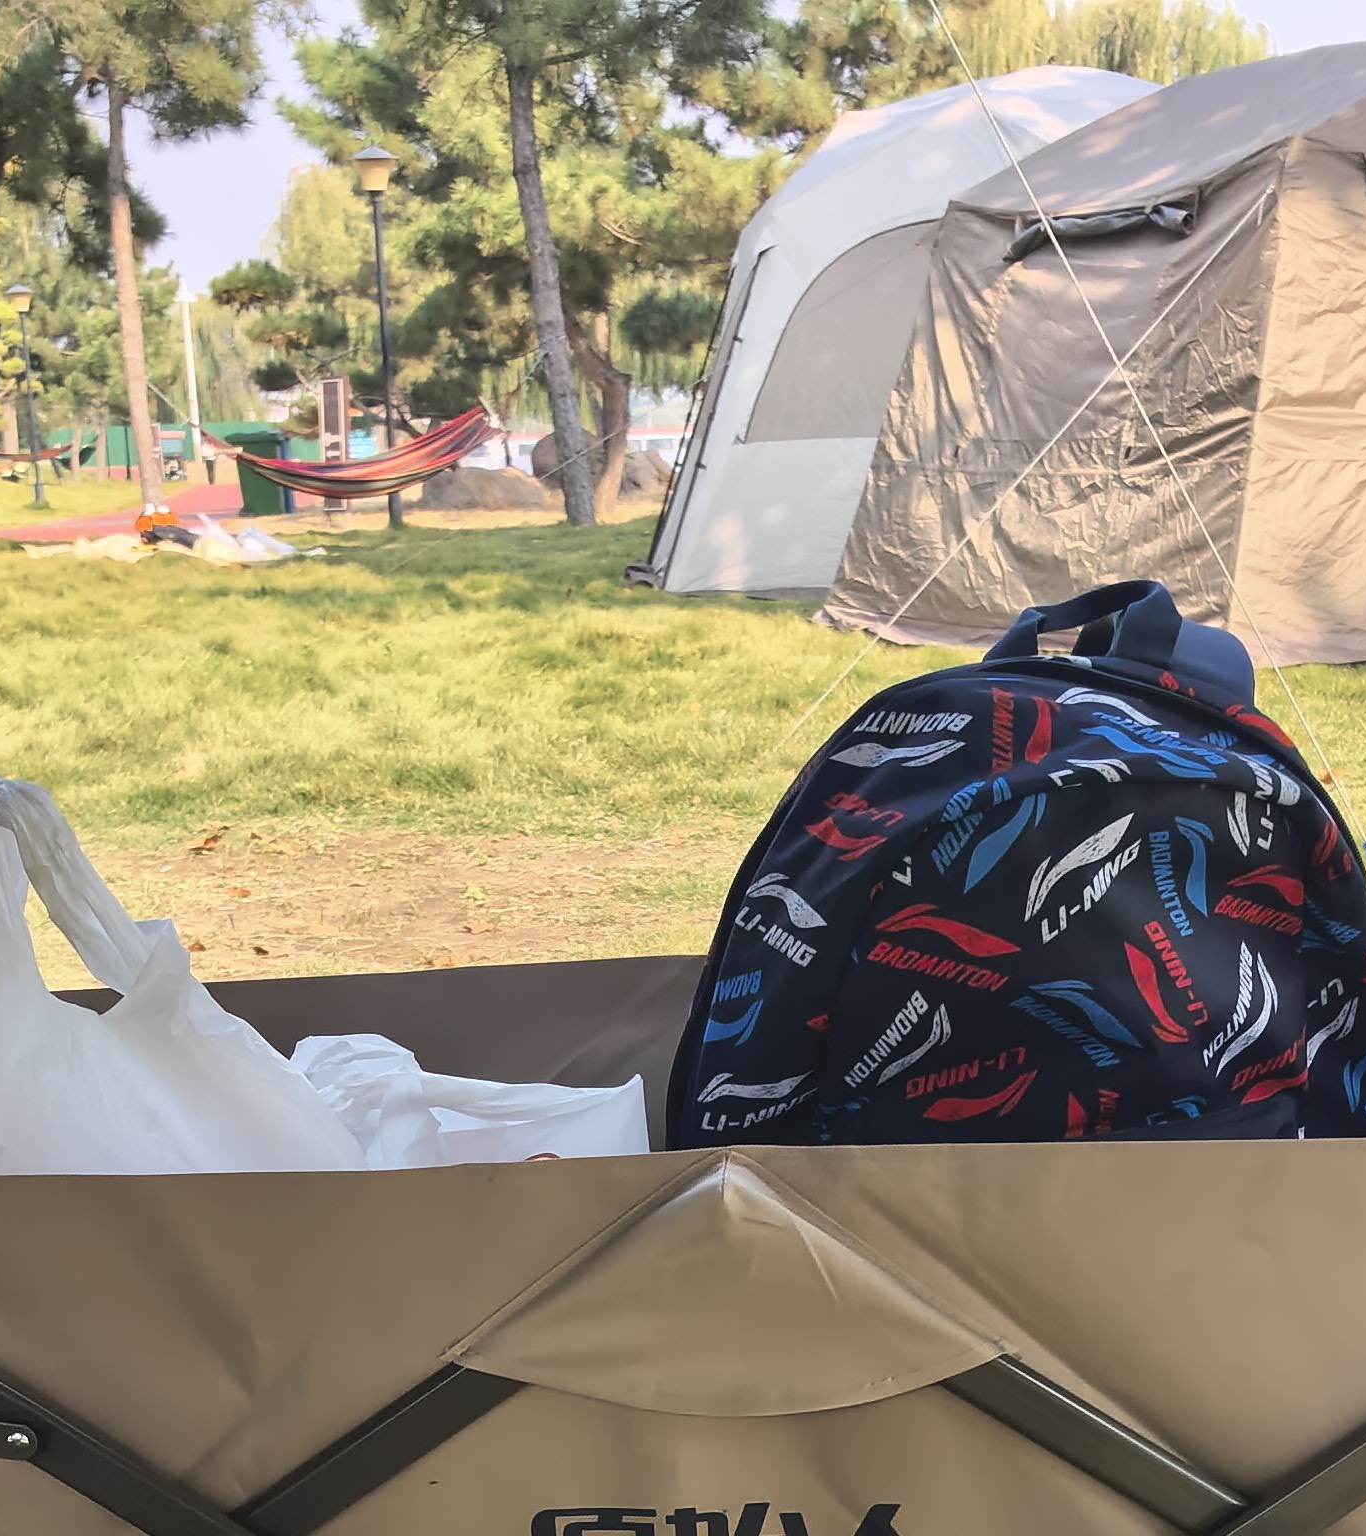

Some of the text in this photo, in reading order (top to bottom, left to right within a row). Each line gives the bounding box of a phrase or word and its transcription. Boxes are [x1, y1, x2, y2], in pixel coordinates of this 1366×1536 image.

[1040, 837, 1143, 944] LI-NING
[1148, 830, 1194, 938] BADMINTON
[735, 906, 818, 968] LI-NING
[866, 940, 1010, 993] BADMINTON
[1143, 919, 1209, 1027] LI-NING
[842, 989, 929, 1089] BADMINTON
[1201, 939, 1254, 1068] BADMINTON
[904, 1045, 1027, 1100] LI-NING
